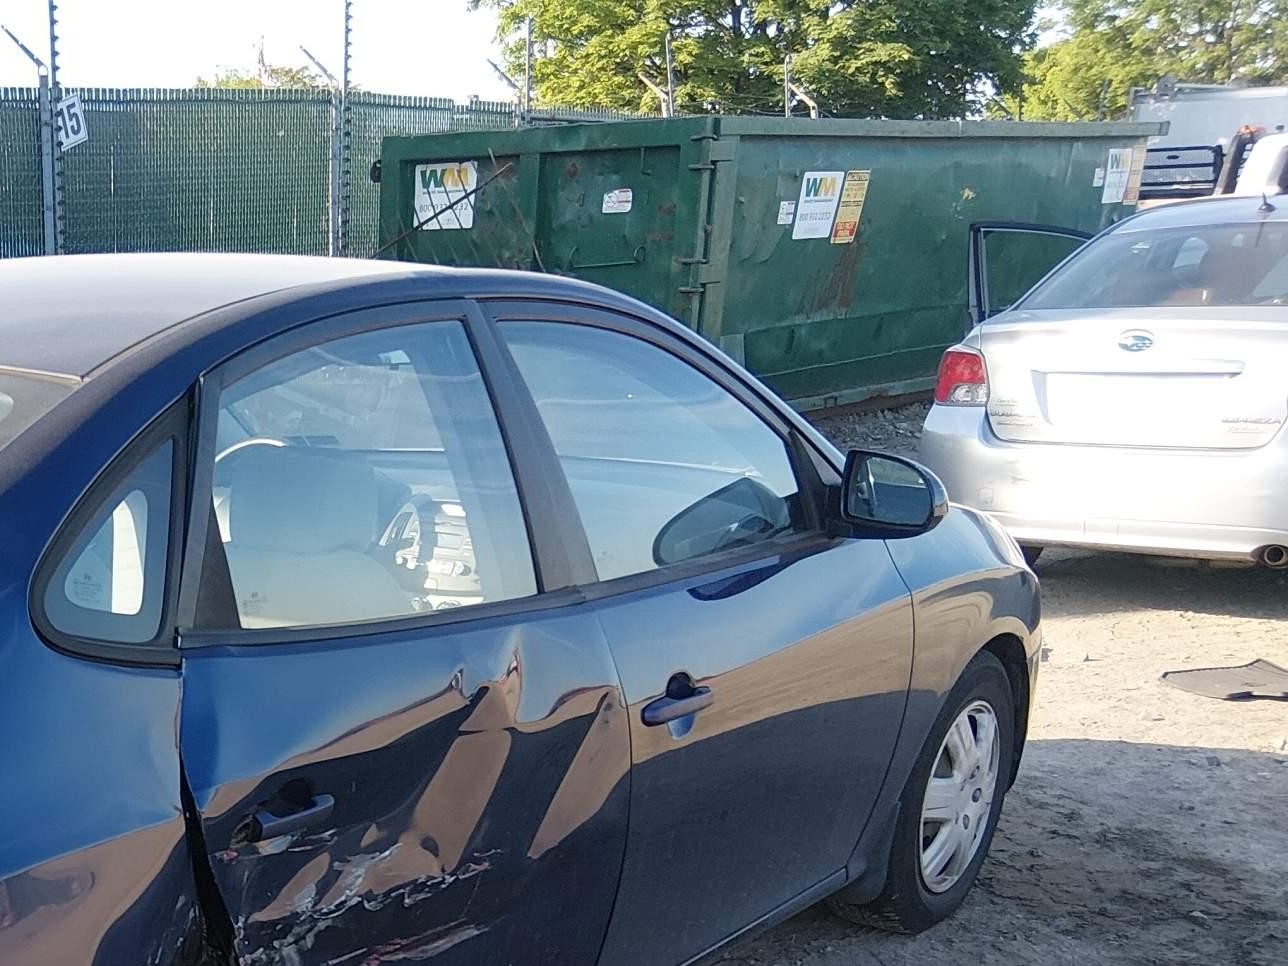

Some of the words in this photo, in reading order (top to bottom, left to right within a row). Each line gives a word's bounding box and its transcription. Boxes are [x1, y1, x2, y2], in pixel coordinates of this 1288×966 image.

[58, 102, 82, 140] 15
[420, 167, 470, 189] WM
[805, 177, 838, 198] WM
